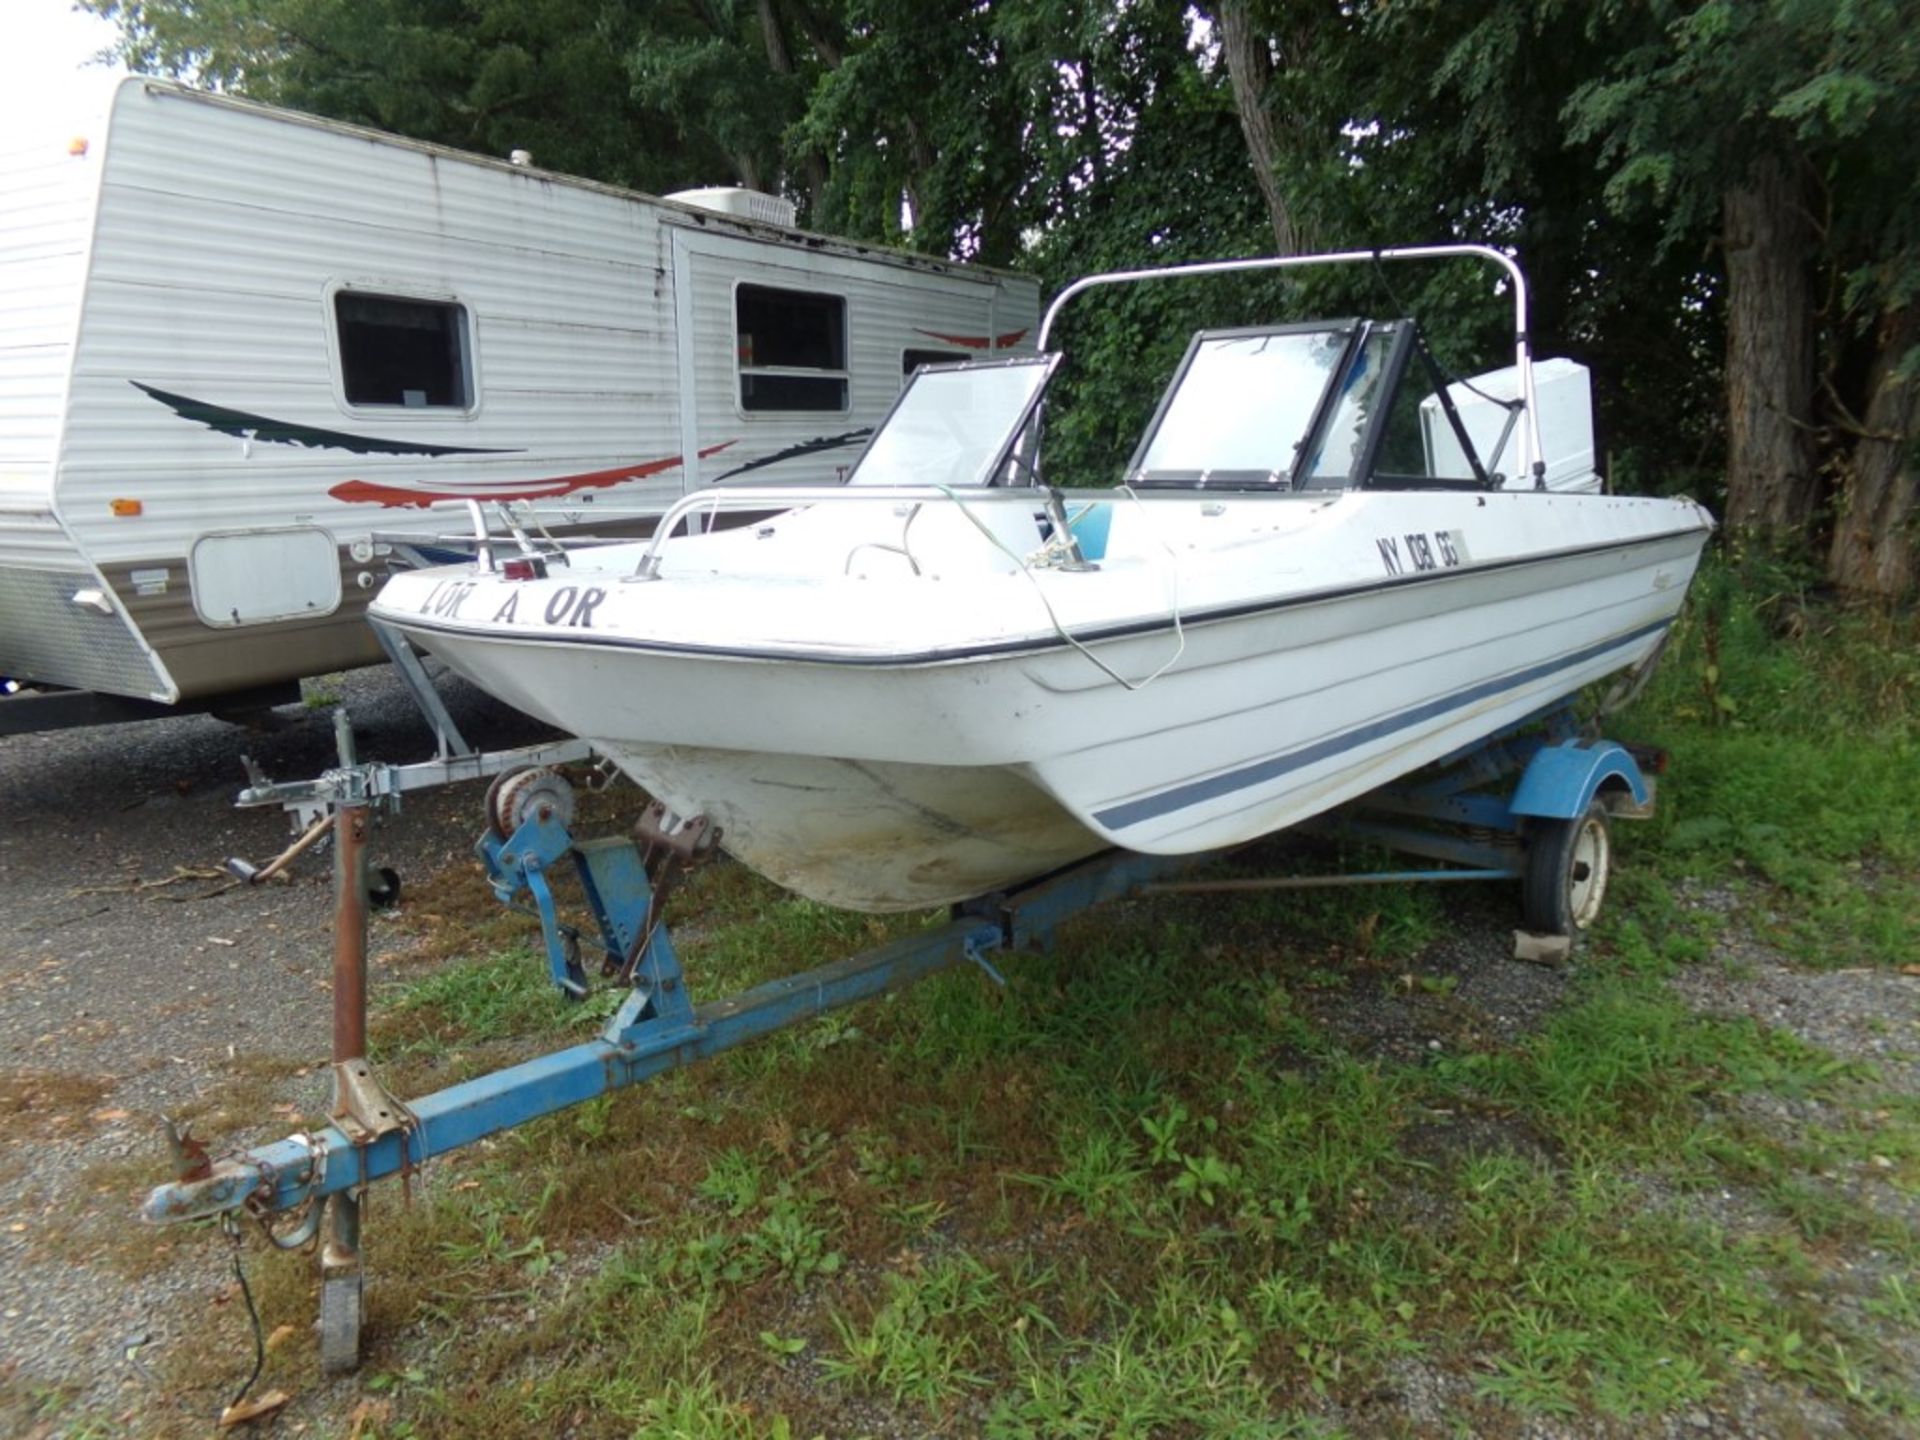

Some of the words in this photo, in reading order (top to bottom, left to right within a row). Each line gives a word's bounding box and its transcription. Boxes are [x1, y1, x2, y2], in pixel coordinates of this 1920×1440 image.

[1375, 536, 1404, 577] NY
[492, 589, 520, 624] A
[543, 585, 607, 628] OR
